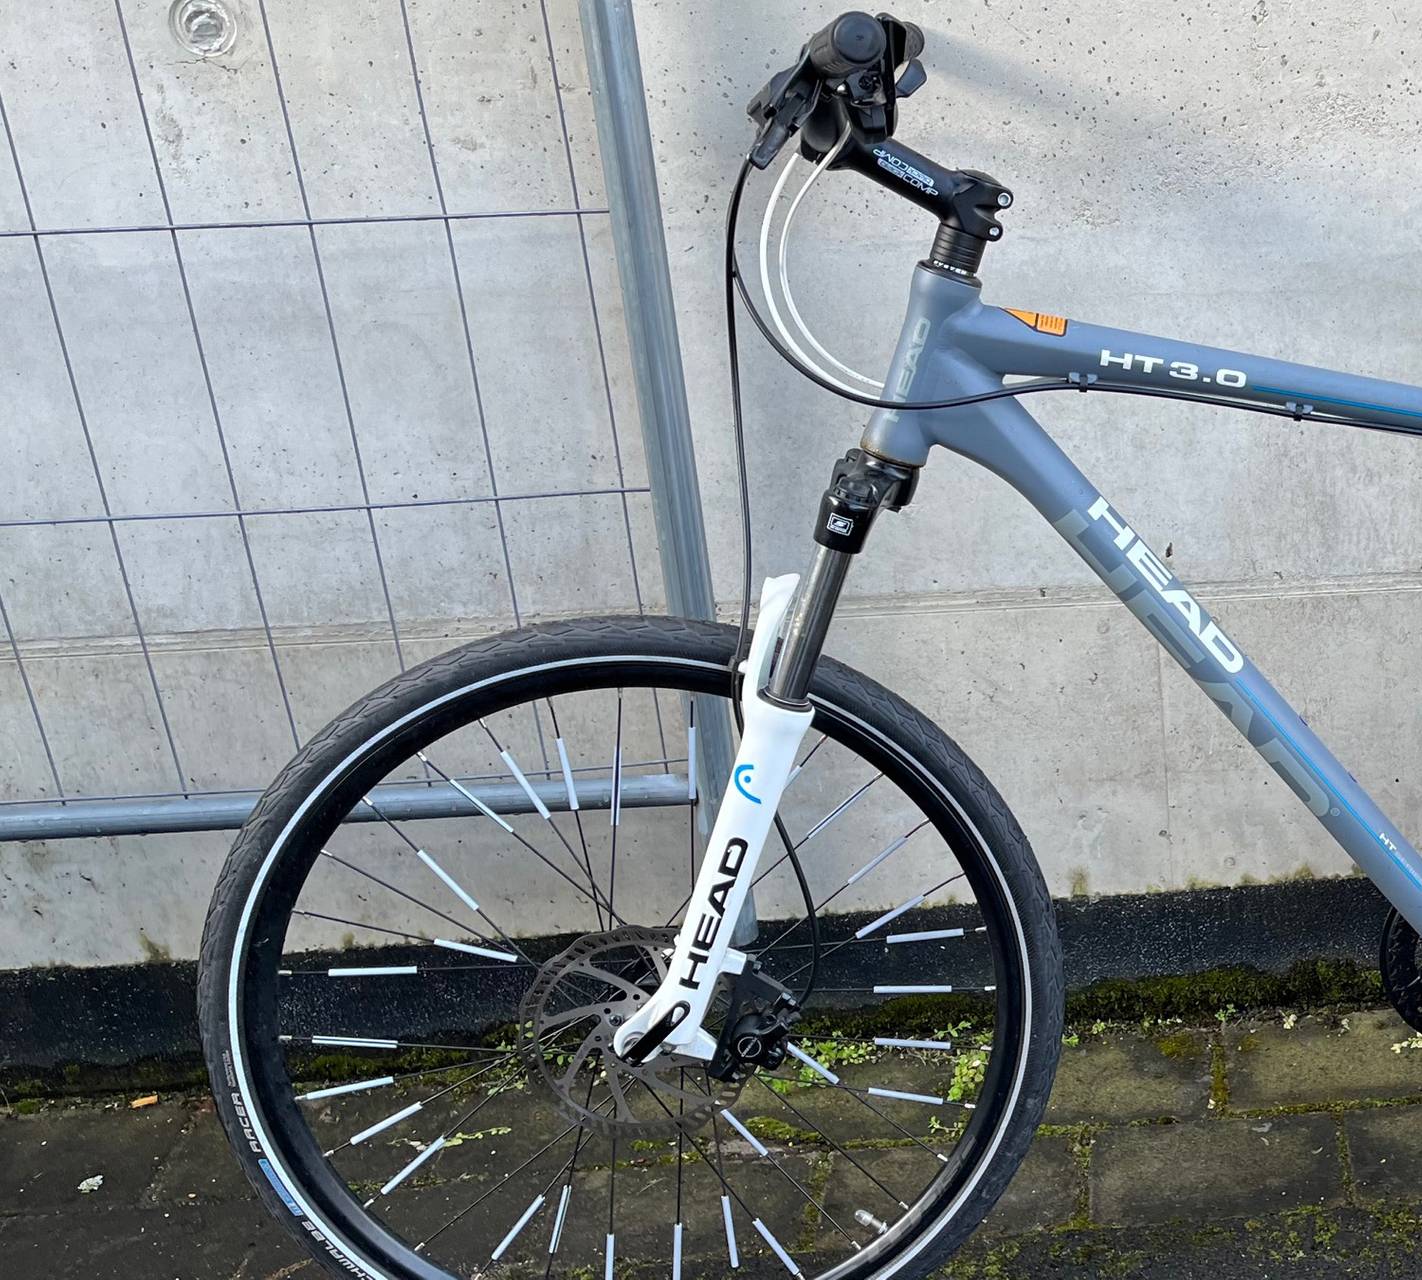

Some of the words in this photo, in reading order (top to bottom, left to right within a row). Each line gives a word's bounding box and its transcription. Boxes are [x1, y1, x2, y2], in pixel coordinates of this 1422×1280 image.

[902, 173, 939, 196] COMP
[1100, 349, 1164, 373] HT
[1169, 361, 1247, 388] 3.0
[1087, 495, 1244, 674] HEAD
[1379, 832, 1397, 850] HT
[679, 837, 748, 990] HEAD
